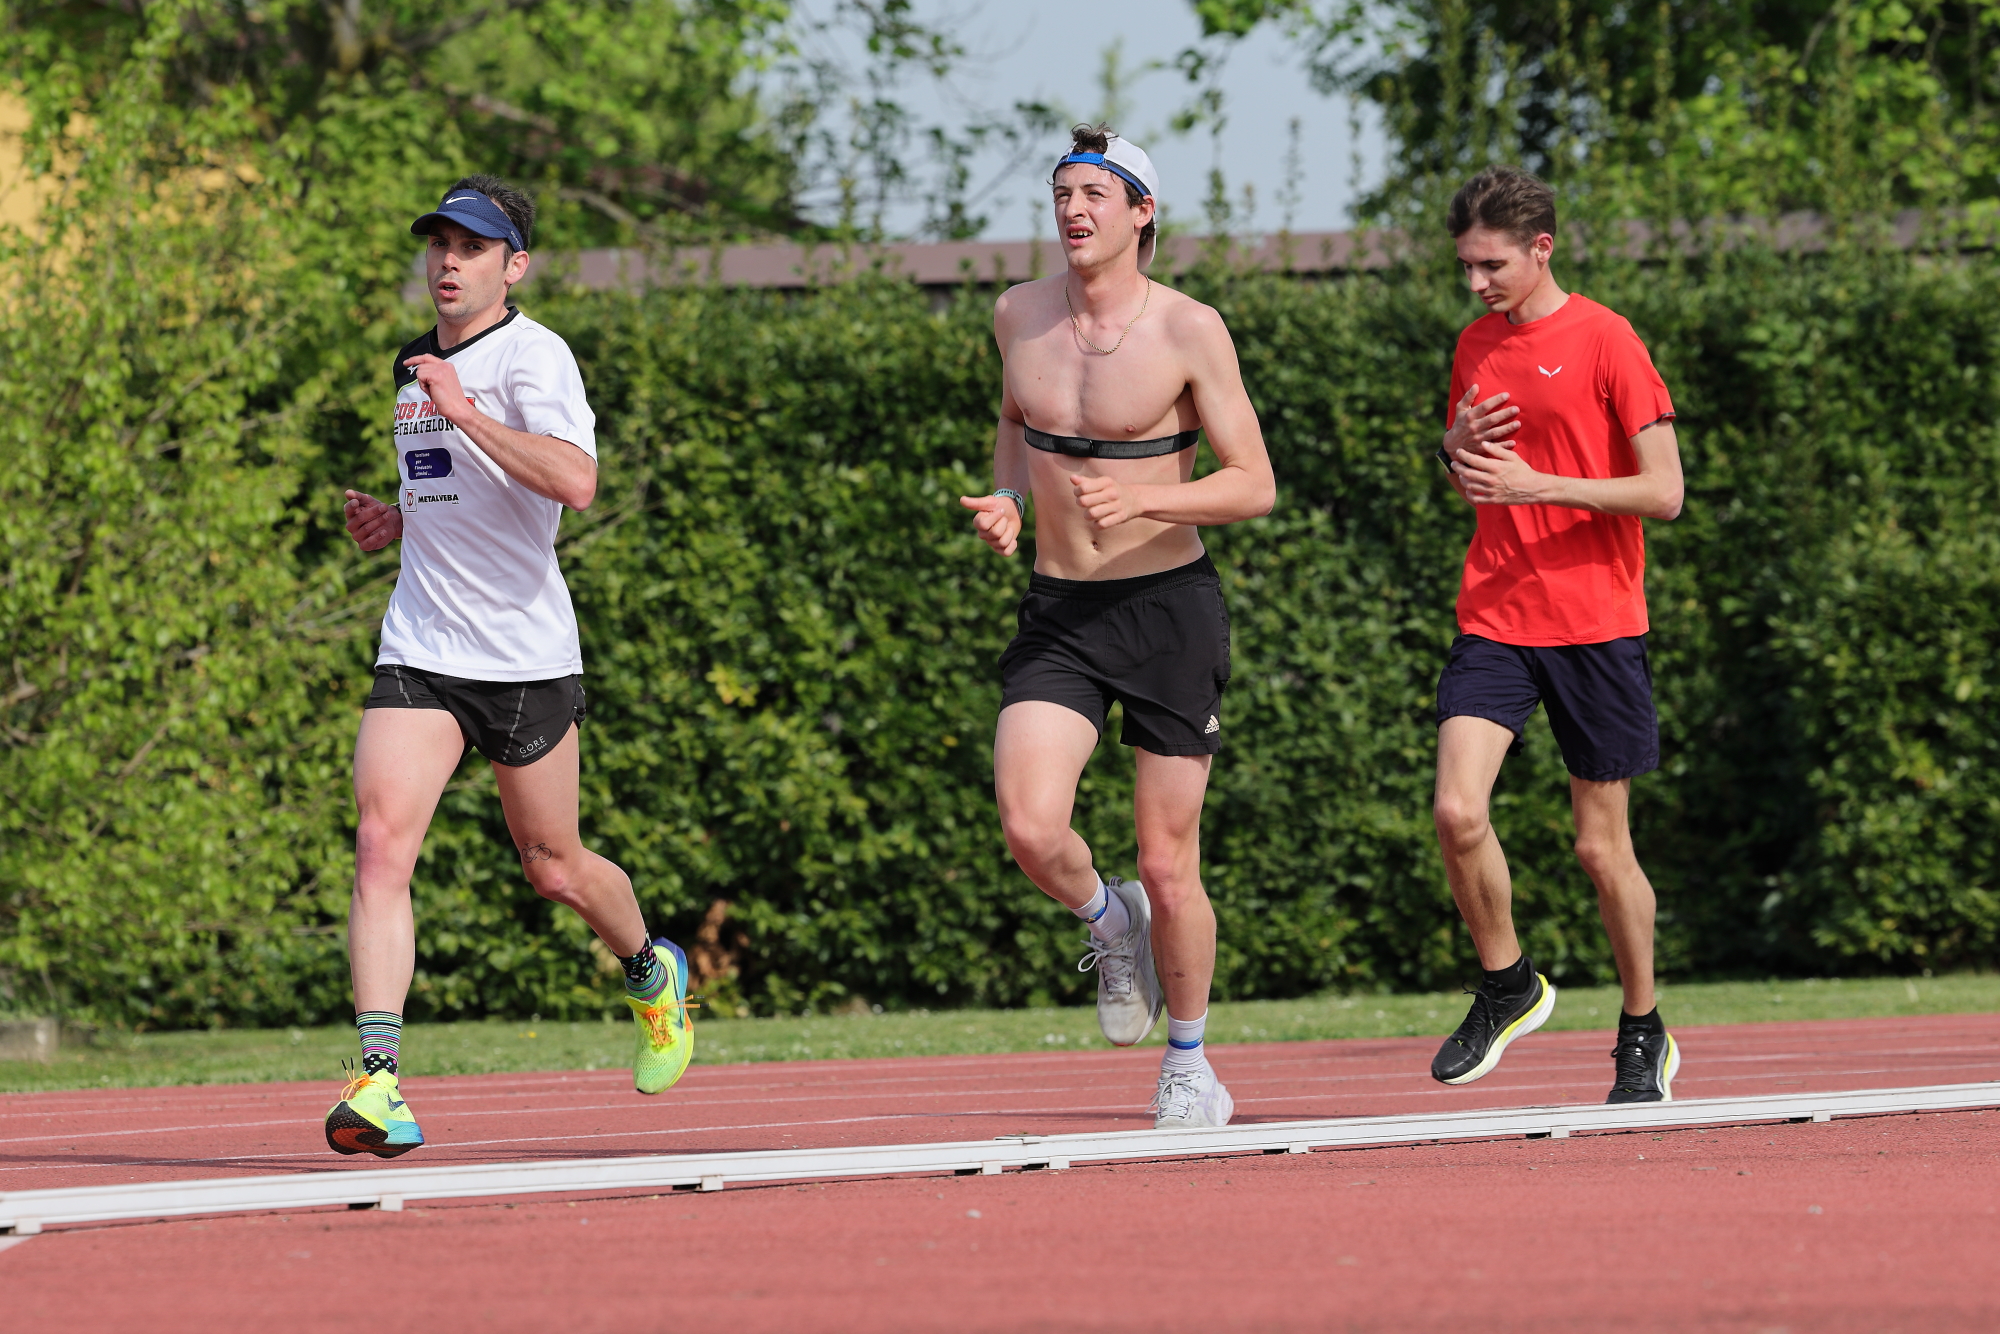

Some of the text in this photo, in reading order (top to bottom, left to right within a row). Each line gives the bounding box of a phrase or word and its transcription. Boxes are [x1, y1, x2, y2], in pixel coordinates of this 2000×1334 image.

[399, 417, 454, 436] TRIATHLON
[418, 494, 459, 503] METALVEBA
[519, 735, 545, 754] GORE
